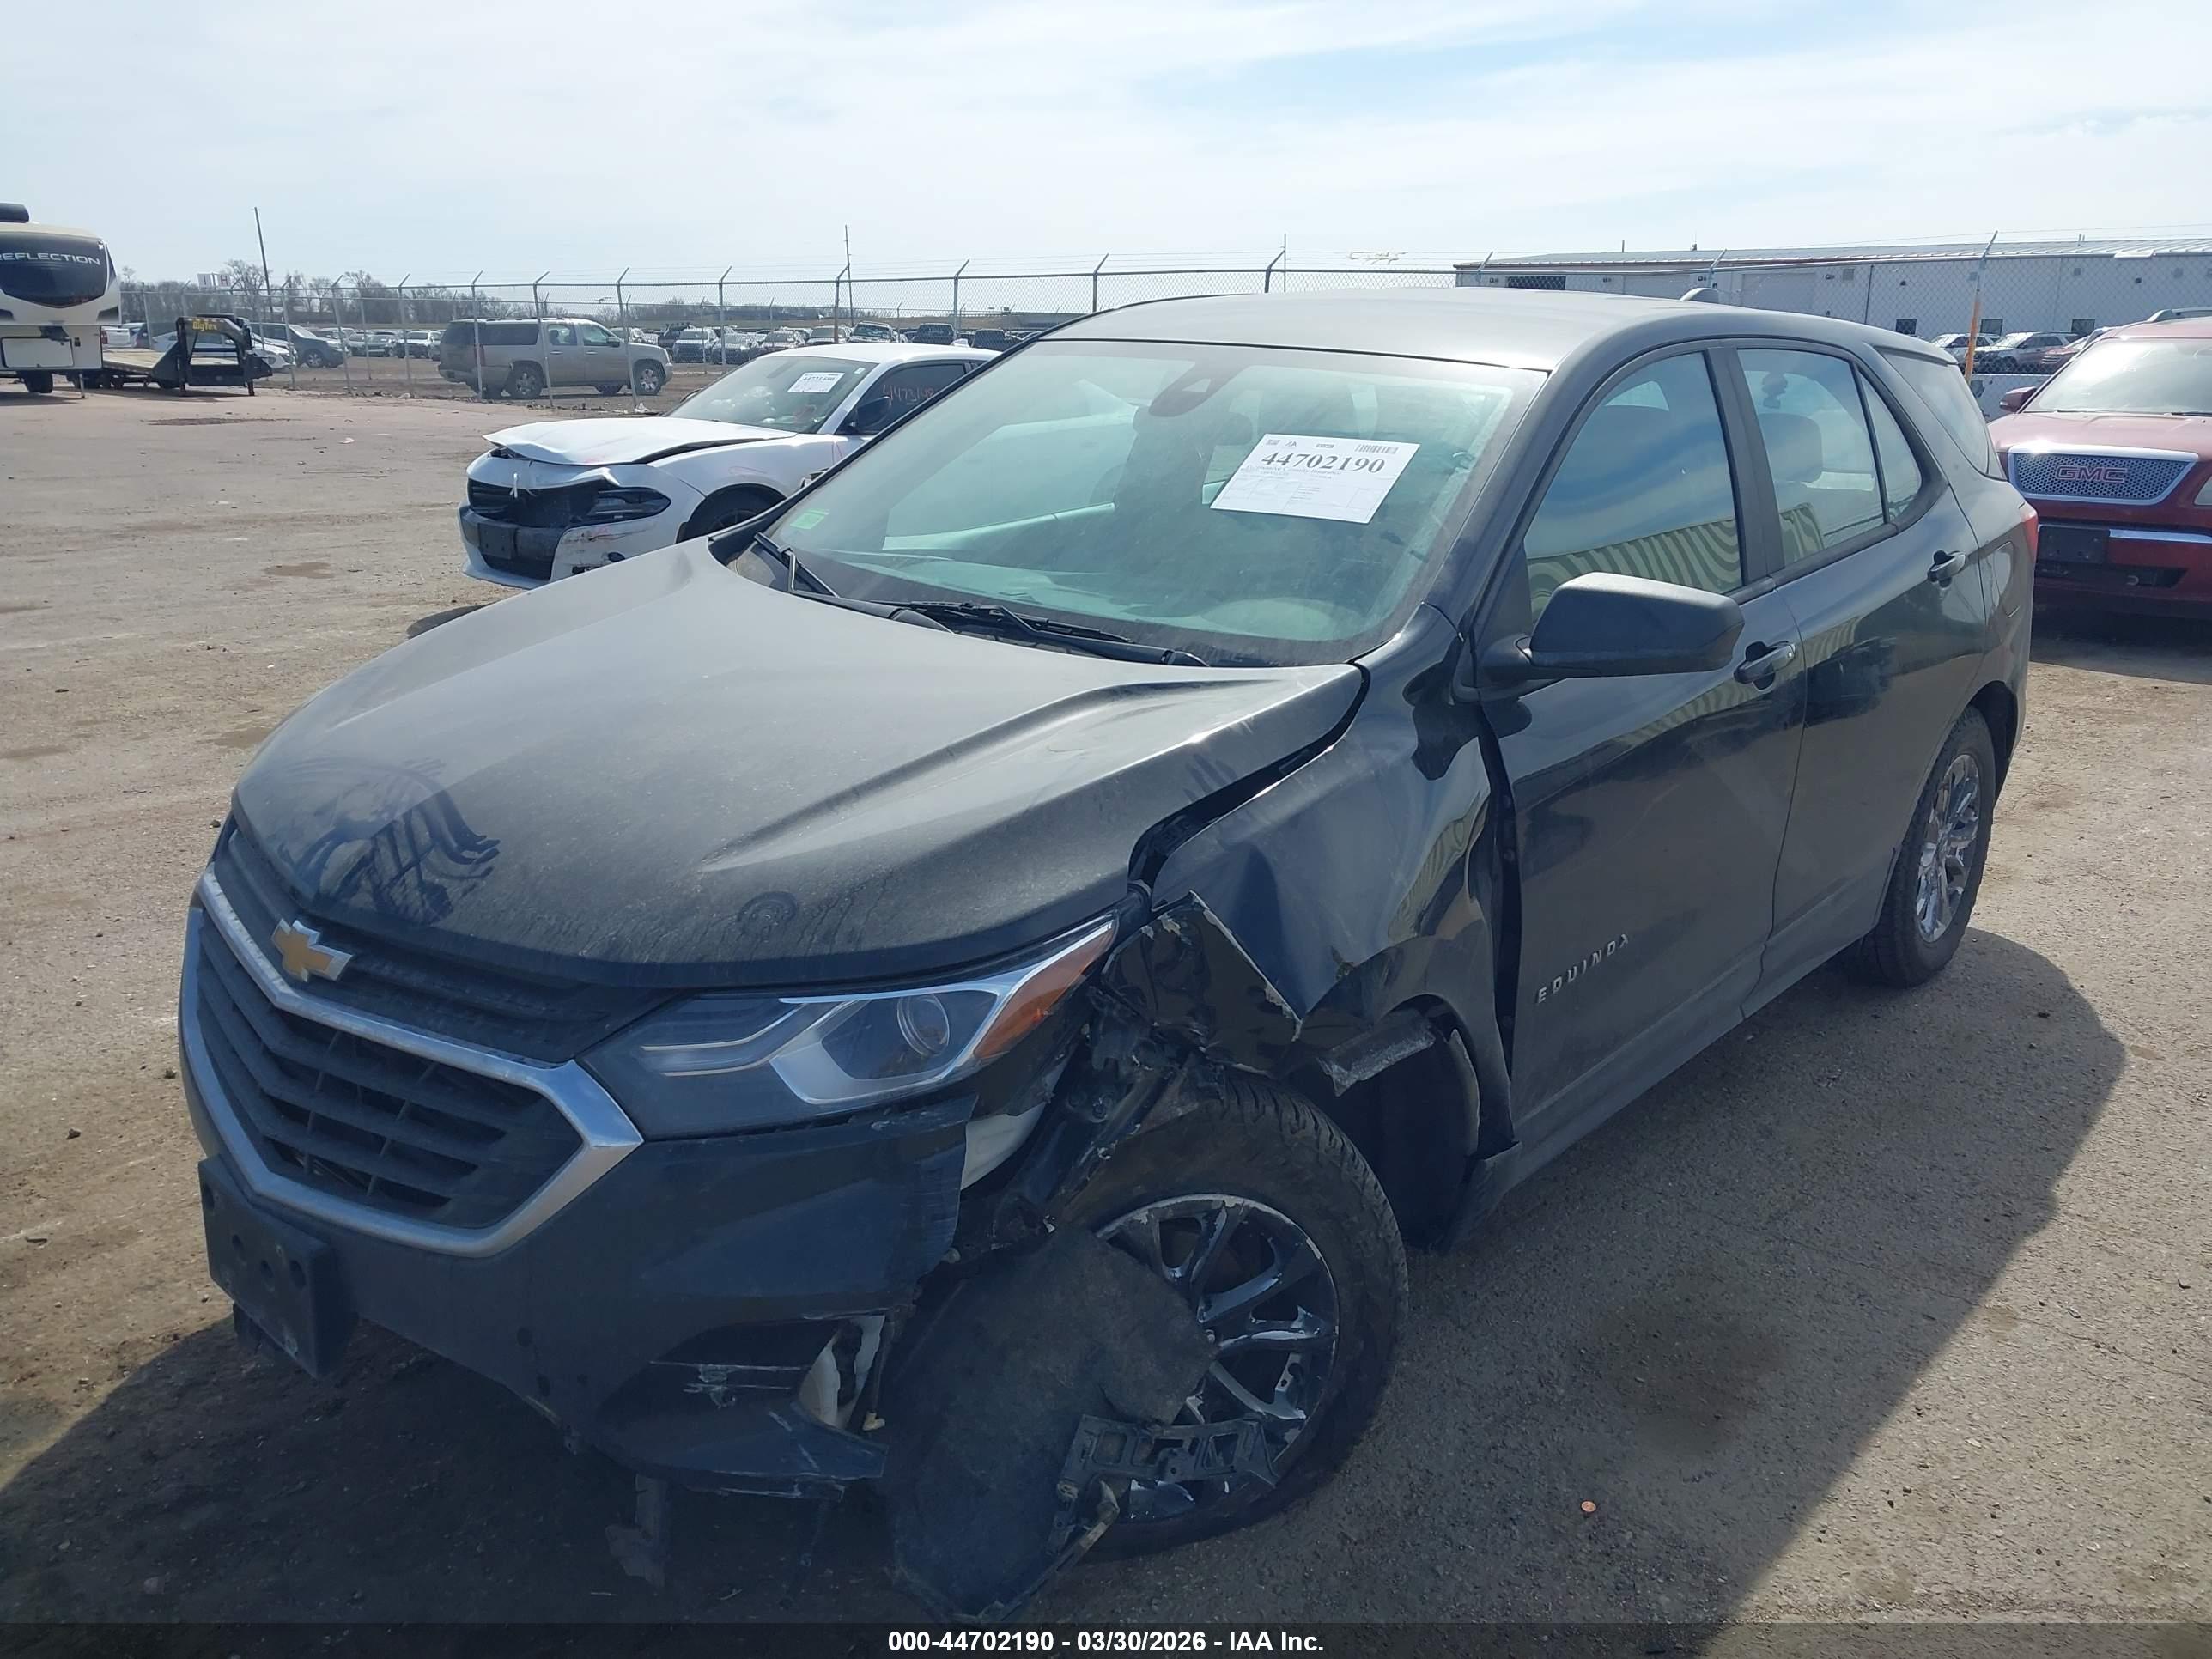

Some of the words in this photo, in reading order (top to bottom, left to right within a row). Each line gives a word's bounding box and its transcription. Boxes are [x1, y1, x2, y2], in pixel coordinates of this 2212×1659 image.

[0, 252, 100, 265] EFLECTION
[1261, 452, 1385, 473] 44702190
[2056, 465, 2127, 483] GMC
